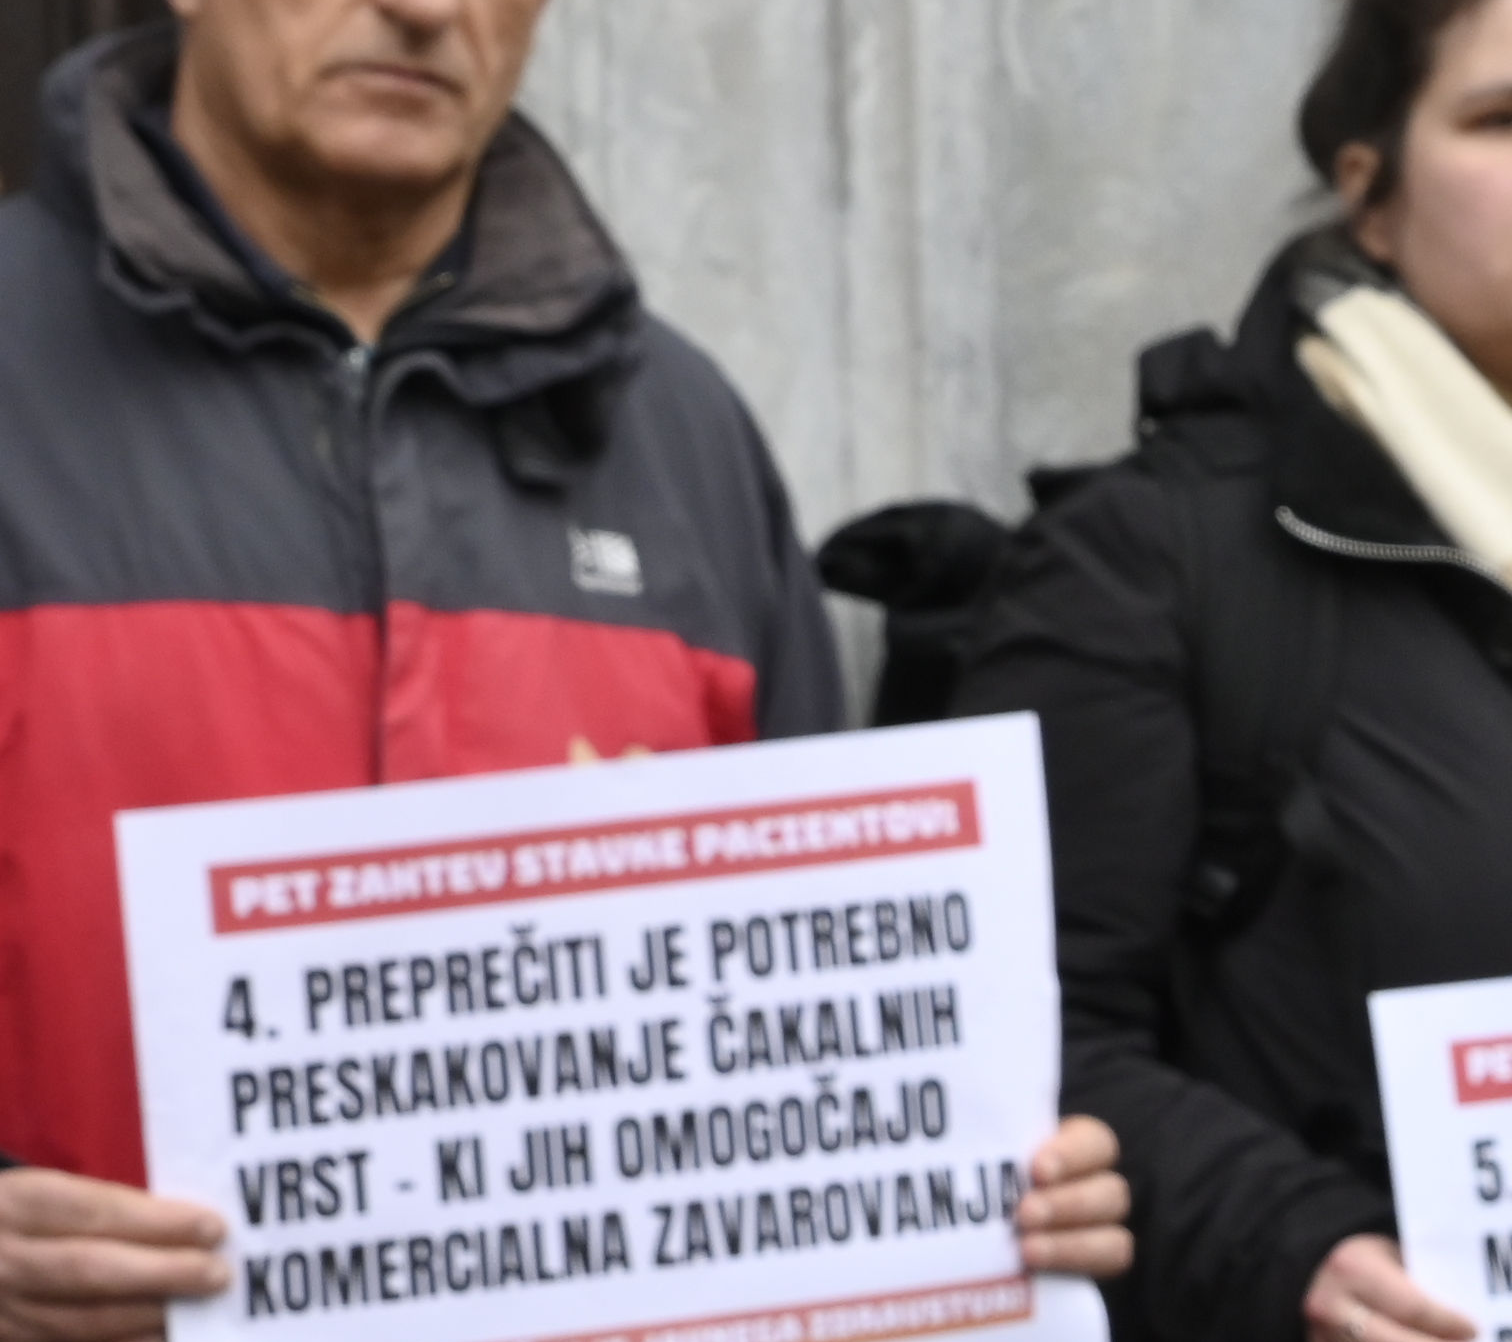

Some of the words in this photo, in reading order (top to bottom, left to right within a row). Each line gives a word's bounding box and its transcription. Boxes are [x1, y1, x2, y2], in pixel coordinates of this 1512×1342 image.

[230, 870, 321, 919] PET
[328, 848, 508, 908] ZAHTEV
[512, 829, 689, 888] STAVKE
[223, 977, 279, 1040] 4.
[305, 923, 607, 1032] PREPREČITI
[628, 926, 691, 992] JE
[709, 891, 972, 982] POTREBNO
[231, 1019, 685, 1134] PRESKAKOVANJE
[707, 984, 960, 1075] ČAKALNIH
[238, 1150, 370, 1226] VRST
[437, 1134, 487, 1203] KI
[509, 1124, 592, 1193] JIH
[617, 1072, 947, 1178] OMOGOČAJO
[246, 1212, 630, 1318] KOMERCIALNA
[652, 1160, 1026, 1266] ZAVAROVANJA
